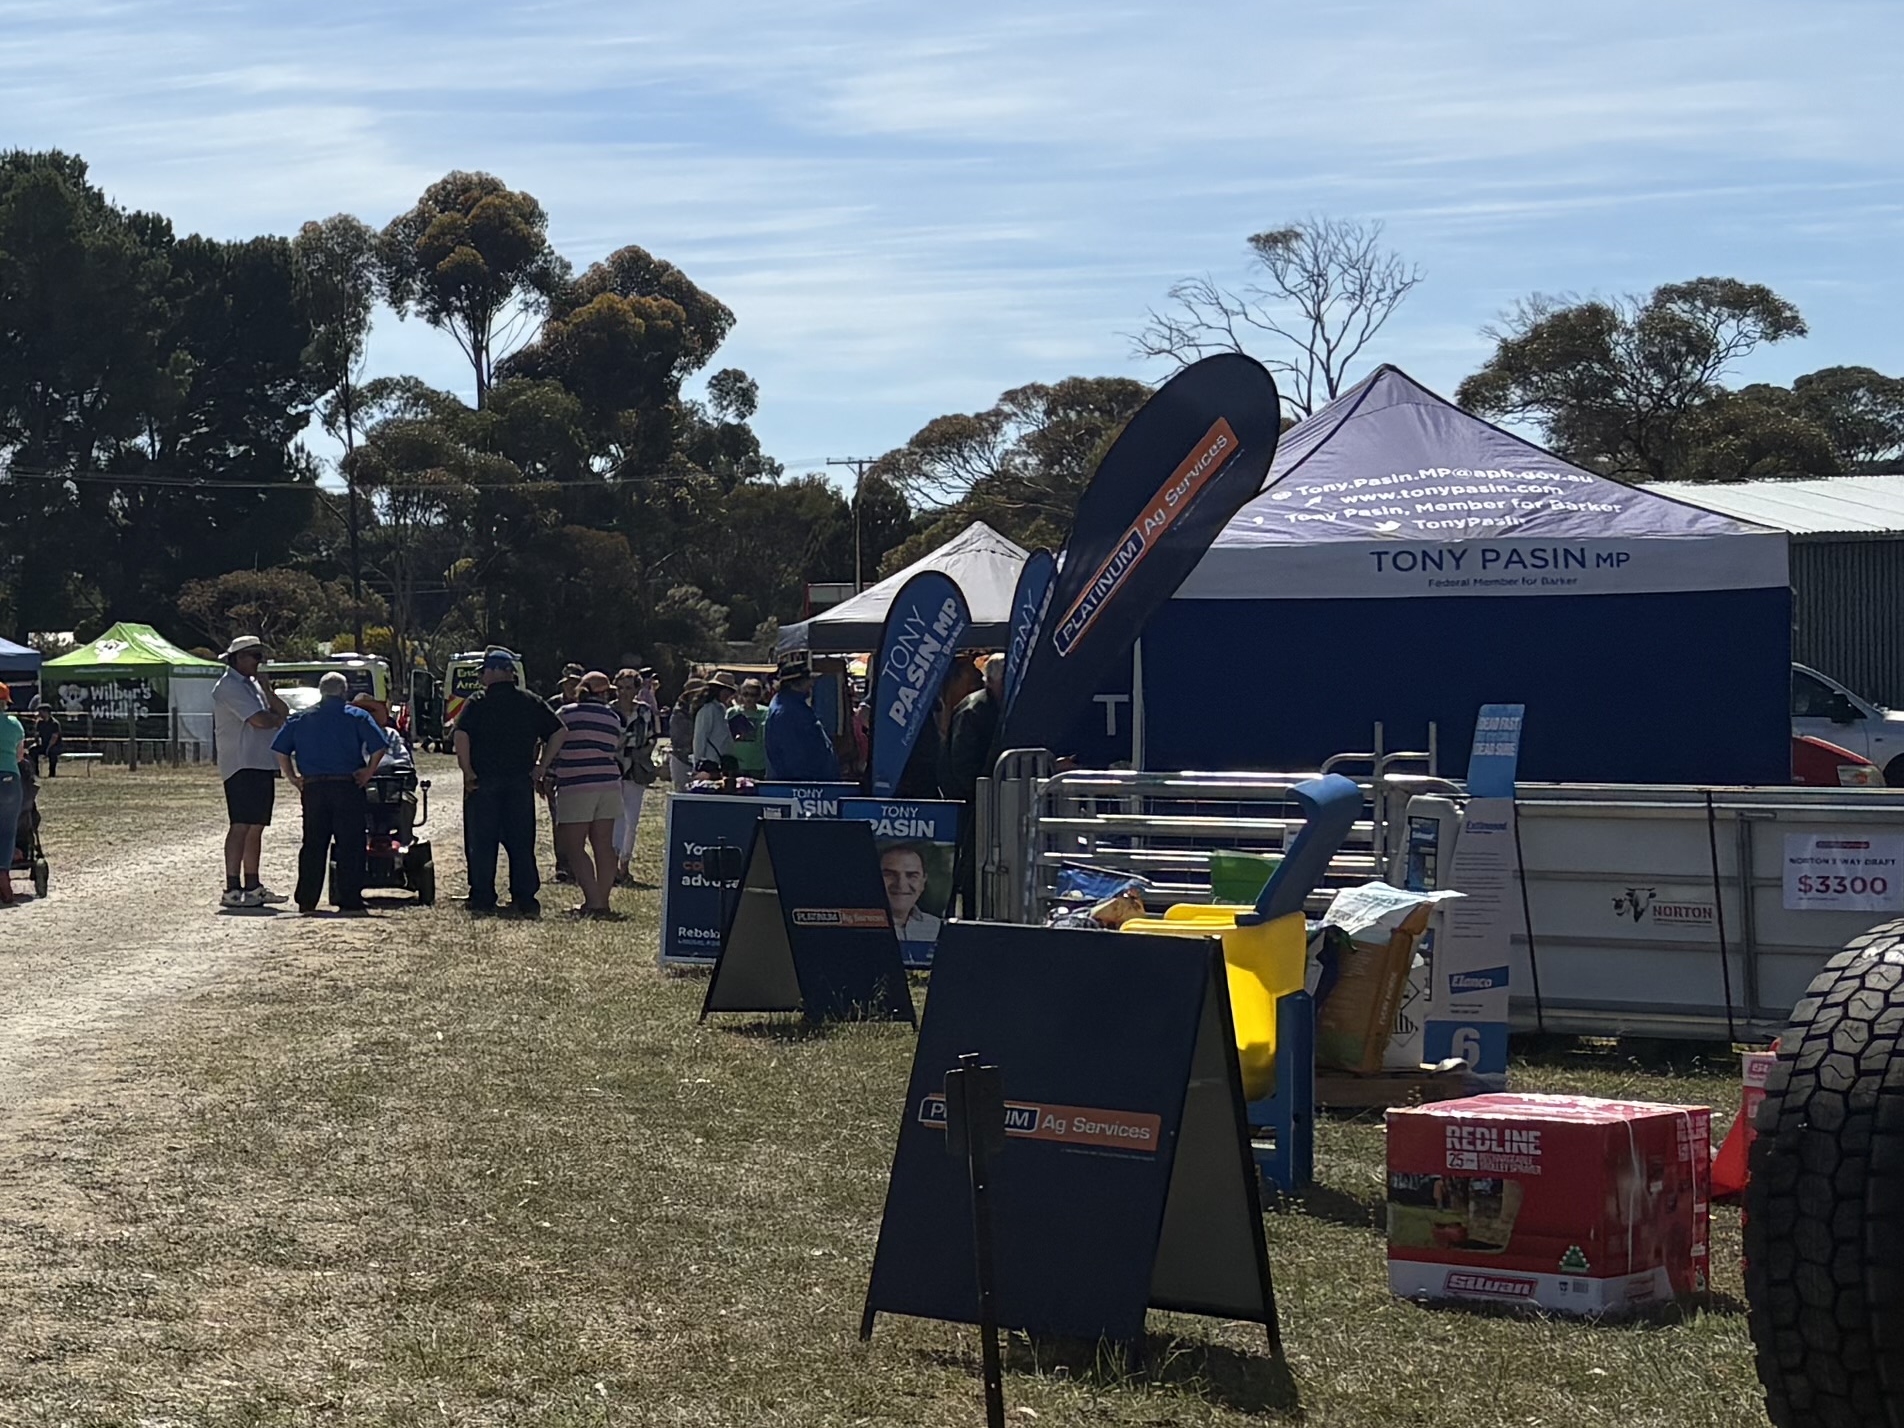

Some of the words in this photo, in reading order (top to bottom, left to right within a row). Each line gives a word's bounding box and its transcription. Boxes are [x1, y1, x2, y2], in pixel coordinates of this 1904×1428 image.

[1340, 483, 1564, 503] www.tonypasin.com
[1062, 539, 1137, 641] PLATINUM
[1144, 507, 1167, 536] Ag
[1165, 434, 1228, 507] Services
[1370, 548, 1467, 572] TONY
[1481, 547, 1587, 570] PASIN
[1596, 552, 1630, 568] MP
[882, 605, 925, 682] TONY
[889, 633, 941, 727] PASIN
[933, 597, 958, 637] MP
[792, 789, 823, 799] TONY
[792, 800, 838, 817] ASIN
[881, 806, 919, 818] TONY
[1797, 874, 1888, 895] $3300
[1653, 905, 1712, 919] NORTON
[1452, 975, 1492, 988] Elanco
[1451, 1027, 1480, 1070] 6
[1042, 1114, 1066, 1133] Ag
[1073, 1117, 1151, 1140] Services
[1446, 1125, 1541, 1155] REDLINE
[1449, 1152, 1464, 1167] 25
